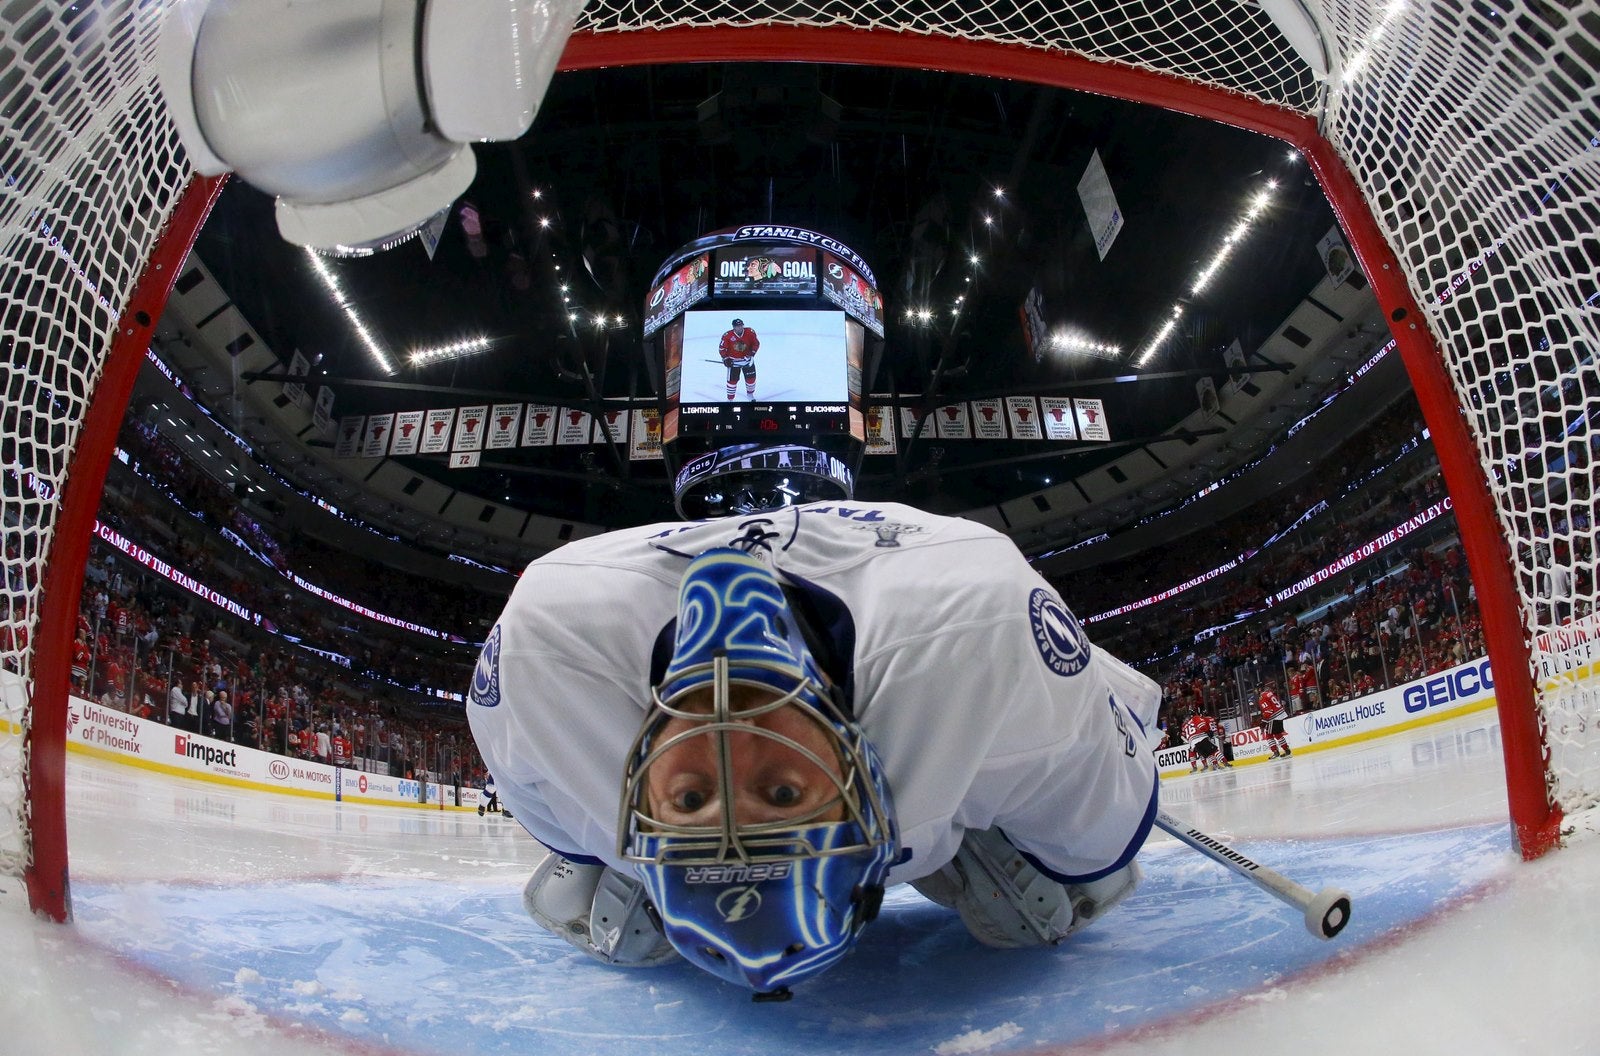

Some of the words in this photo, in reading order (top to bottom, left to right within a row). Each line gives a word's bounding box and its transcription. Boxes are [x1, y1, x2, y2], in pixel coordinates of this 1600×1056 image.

[738, 226, 821, 242] STANLEY
[821, 236, 851, 255] CUP
[720, 260, 747, 278] ONE
[783, 260, 816, 278] GOAL
[155, 358, 173, 381] FINAL
[1355, 346, 1388, 379] WELCOME
[1386, 338, 1397, 351] TO
[682, 406, 720, 414] LIGHTNING
[805, 405, 847, 413] BLACKHAWKS
[459, 455, 471, 465] 72
[1275, 577, 1317, 603] WELCOME
[1315, 567, 1329, 582] TO
[1329, 554, 1356, 575] GAME
[1355, 549, 1362, 561] 3
[1362, 541, 1378, 557] OF
[1376, 529, 1397, 549] THE
[1396, 502, 1442, 538] STANLEY
[100, 523, 131, 554] GAME
[130, 544, 138, 558] 3
[138, 550, 151, 566] OF
[152, 556, 171, 578] THE
[172, 569, 212, 599] STANLEY
[211, 590, 228, 607] CUP
[226, 600, 251, 621] FINAL
[1089, 608, 1122, 624] WELCOME
[1122, 603, 1132, 613] TO
[1132, 597, 1153, 610] GAME
[1153, 595, 1158, 603] 3
[1158, 591, 1167, 601] OF
[1166, 586, 1180, 598] THE
[1179, 574, 1207, 592] STANLEY
[1206, 568, 1220, 580] CUP
[1219, 560, 1238, 574] FINAL
[294, 575, 323, 597] WELCOME
[323, 590, 333, 601] TO
[332, 593, 351, 609] GAME
[350, 602, 355, 610] 3
[355, 603, 364, 614] OF
[362, 606, 376, 619] THE
[376, 612, 407, 628] STANLEY
[406, 621, 420, 632] CUP
[420, 625, 439, 638] FINAL
[1035, 624, 1050, 650] BAY
[1048, 655, 1082, 675] TAMPA
[83, 704, 139, 738] University
[1315, 711, 1355, 731] MAXWELL
[1355, 701, 1386, 721] HOUSE
[82, 727, 94, 742] of
[97, 728, 141, 754] Phoenix
[1185, 723, 1196, 739] 16
[187, 734, 237, 767] impact
[272, 764, 287, 775] KIA
[292, 767, 305, 779] KIA
[306, 771, 332, 784] MOTORS
[1186, 828, 1260, 871] WARRIOR
[684, 861, 794, 884] BAUER
